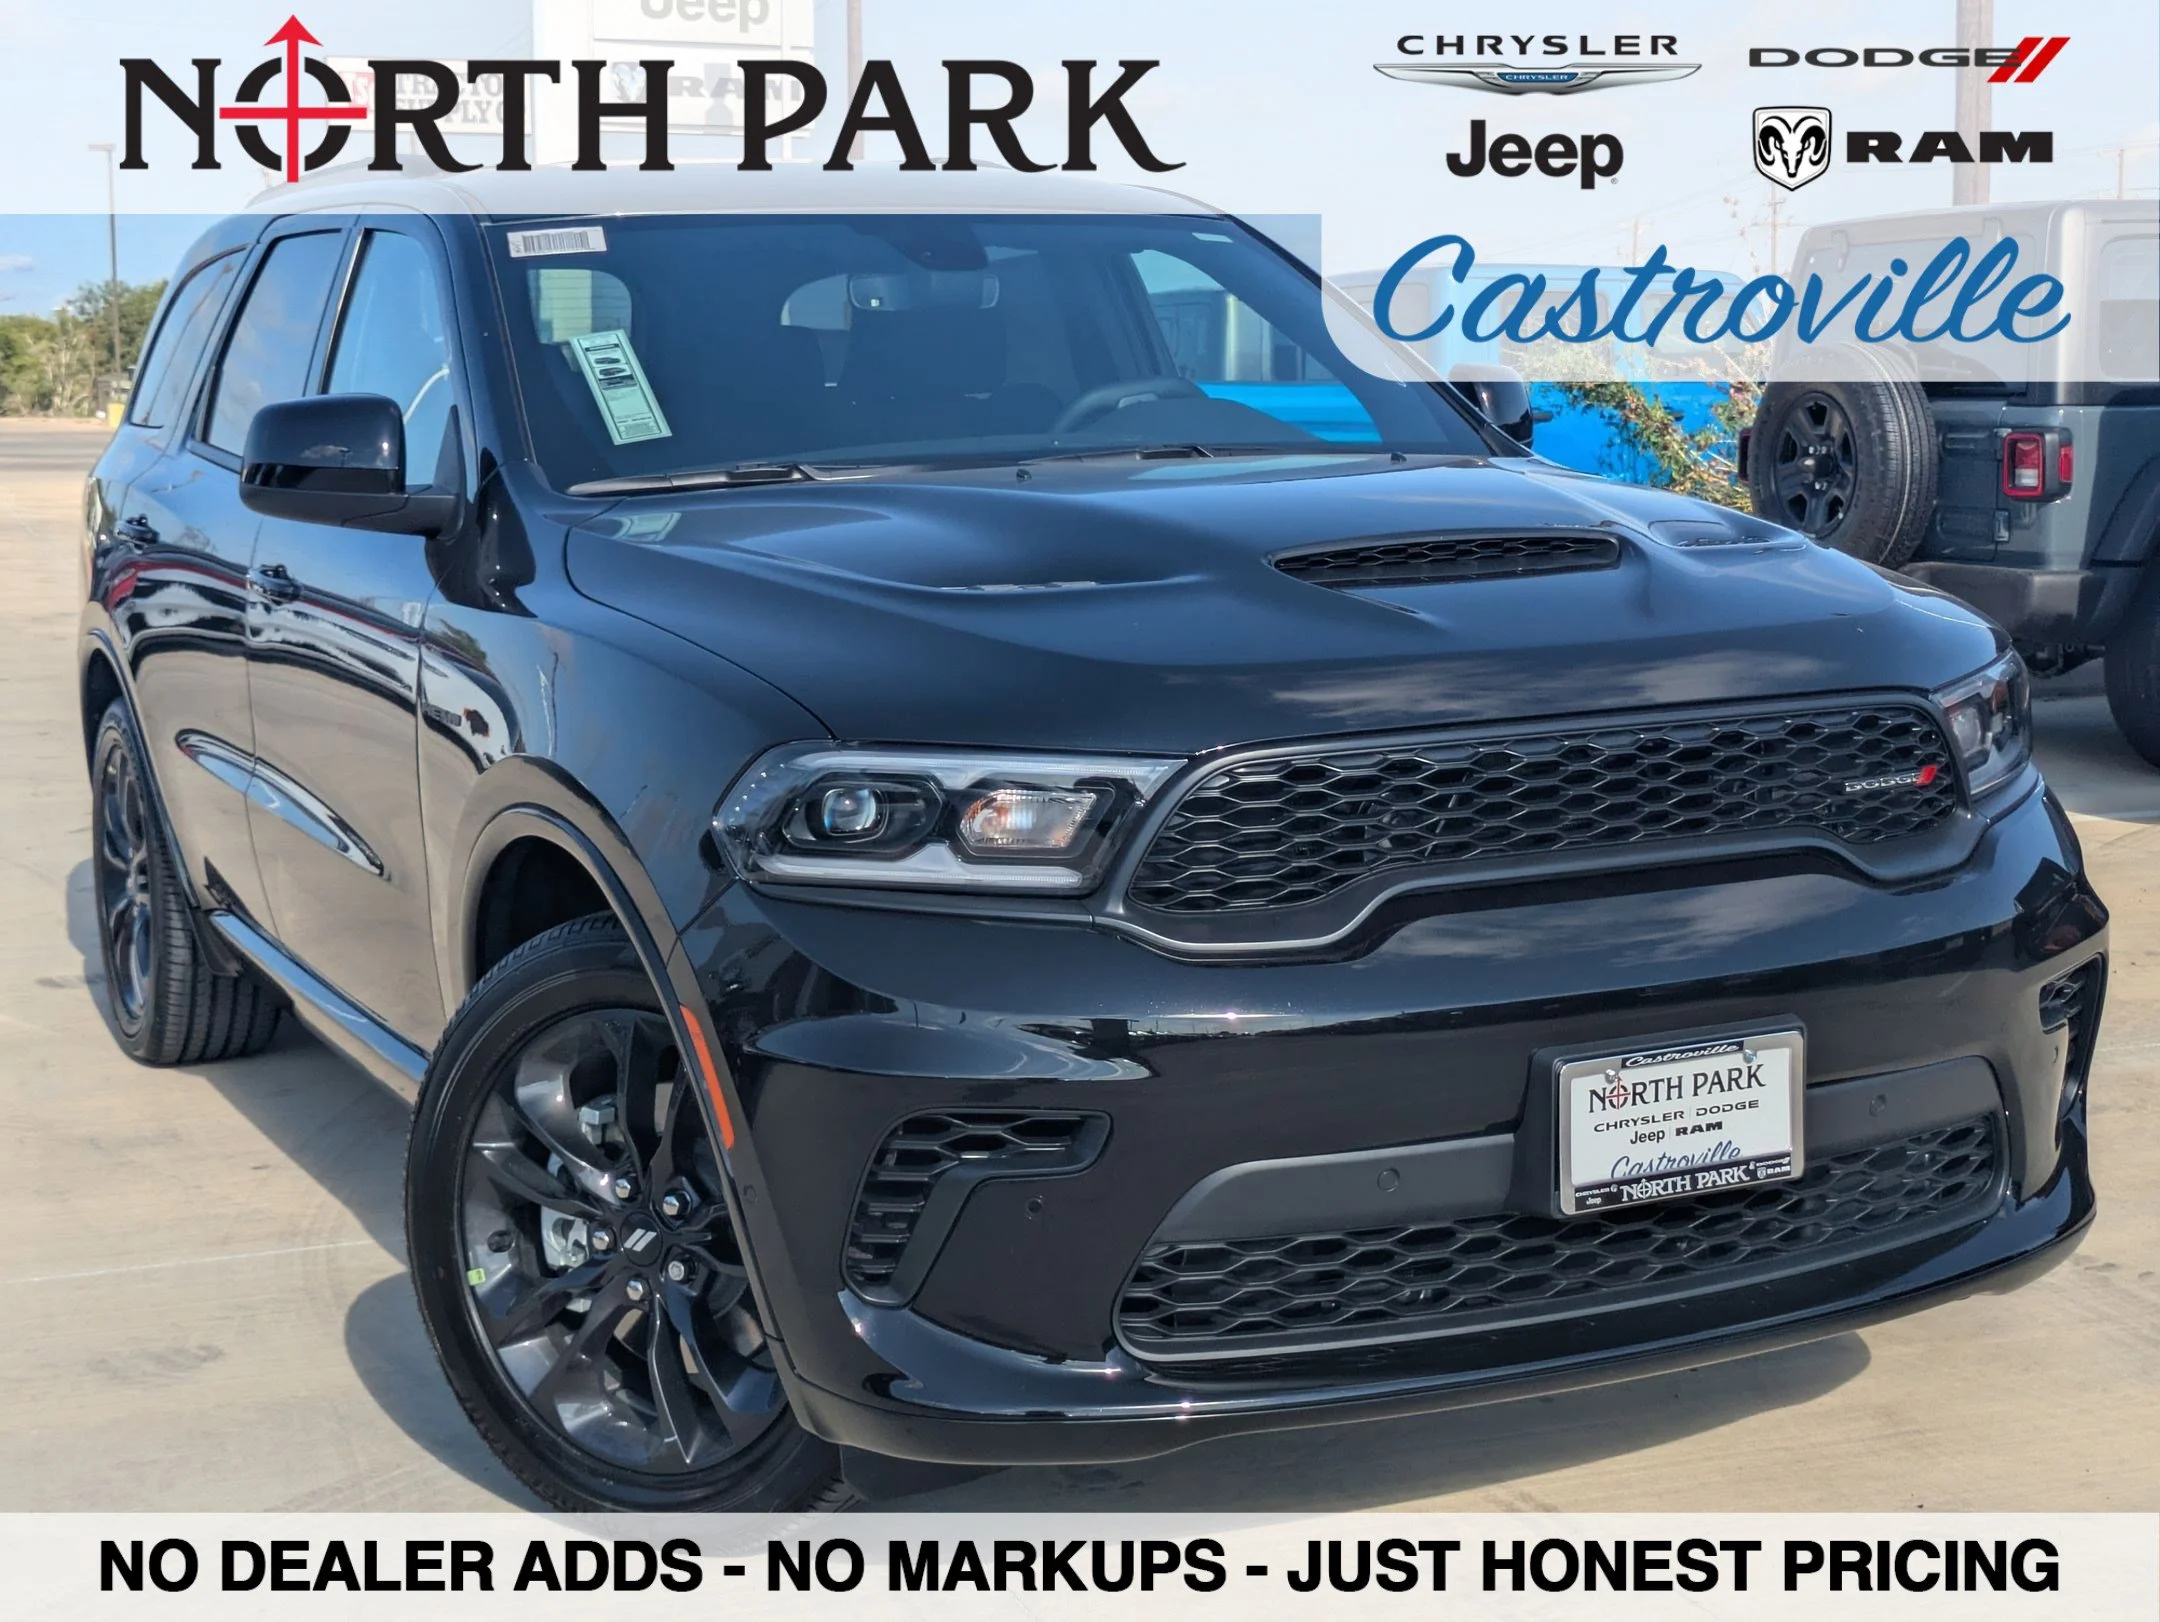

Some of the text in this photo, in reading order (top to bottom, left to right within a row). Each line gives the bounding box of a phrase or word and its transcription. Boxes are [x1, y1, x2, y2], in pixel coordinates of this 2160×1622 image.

[1845, 772, 1921, 792] DODGE
[1625, 1043, 1740, 1068] Castroville
[1588, 1063, 1767, 1114] NORTH PARK
[1593, 1099, 1760, 1133] CHRYSLER DODGE
[1629, 1120, 1723, 1145] Jeep RAM
[1610, 1139, 1742, 1179] Castroville
[1619, 1165, 1751, 1202] NORTH PARK
